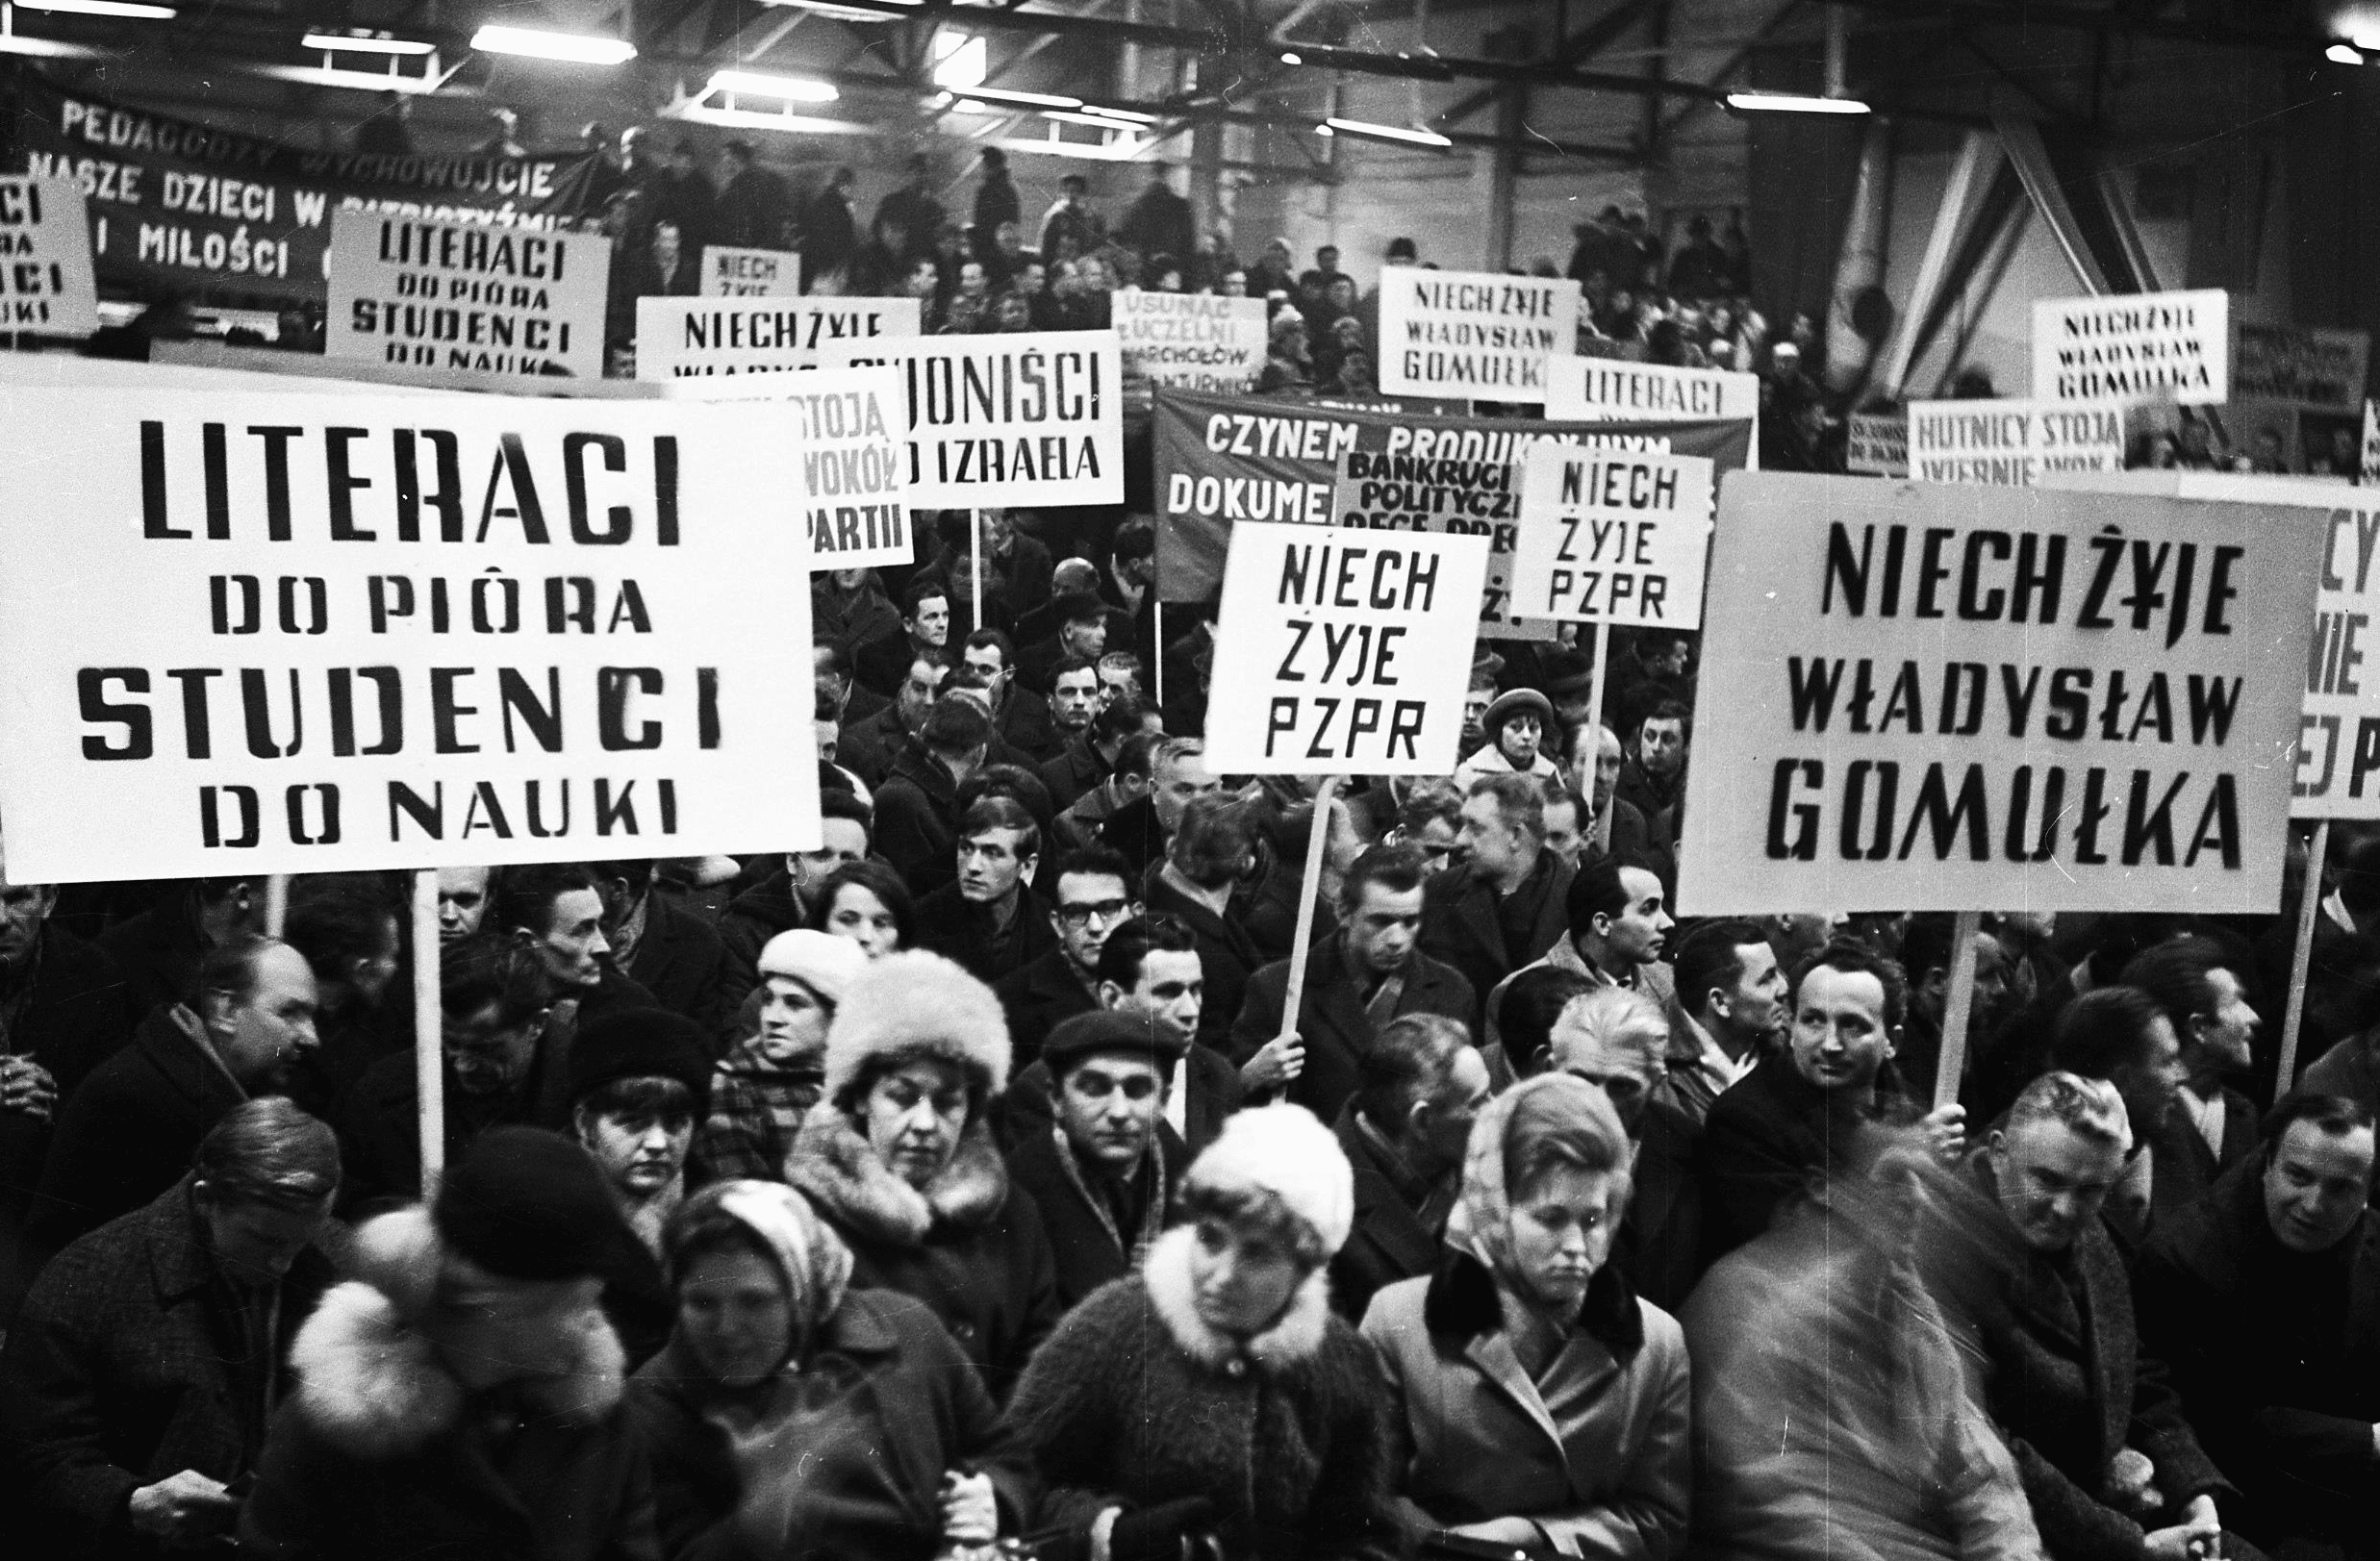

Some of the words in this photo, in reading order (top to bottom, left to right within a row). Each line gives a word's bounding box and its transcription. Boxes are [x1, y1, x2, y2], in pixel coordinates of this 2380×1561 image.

[163, 170, 275, 223] DZIECI
[292, 190, 326, 228] W
[97, 216, 108, 255] I
[379, 220, 565, 282] LITERACI
[397, 271, 439, 298] DO
[719, 254, 777, 280] NIECH
[1415, 281, 1494, 313] NIECH
[352, 297, 570, 354] STUDENCI
[686, 312, 797, 348] NIECH
[1405, 319, 1557, 350] WŁADYSŁAW
[387, 341, 435, 366] DO
[1585, 367, 1723, 415] LITERACI
[1205, 413, 1358, 462] CZYNEM
[1919, 414, 2031, 449] HUTNICY
[140, 420, 680, 546] LITERACI
[937, 435, 1101, 484] IZRAELA
[1560, 461, 1678, 510] NIECH
[209, 574, 329, 636] DO
[367, 567, 653, 635] PIÓRA
[1278, 543, 1440, 613] NIECH
[1549, 569, 1667, 618] PZPR
[1821, 520, 2067, 624] NIECH
[2075, 524, 2245, 650] ŻYJE
[1276, 610, 1407, 687] ŻYJE
[77, 667, 722, 761] STUDENCI
[1787, 655, 2244, 746] WŁADYSŁAW
[1265, 696, 1427, 760] PZPR
[199, 783, 342, 849] DO
[388, 778, 679, 843] NAUKI
[1764, 757, 2242, 870] GOMUŁKA
